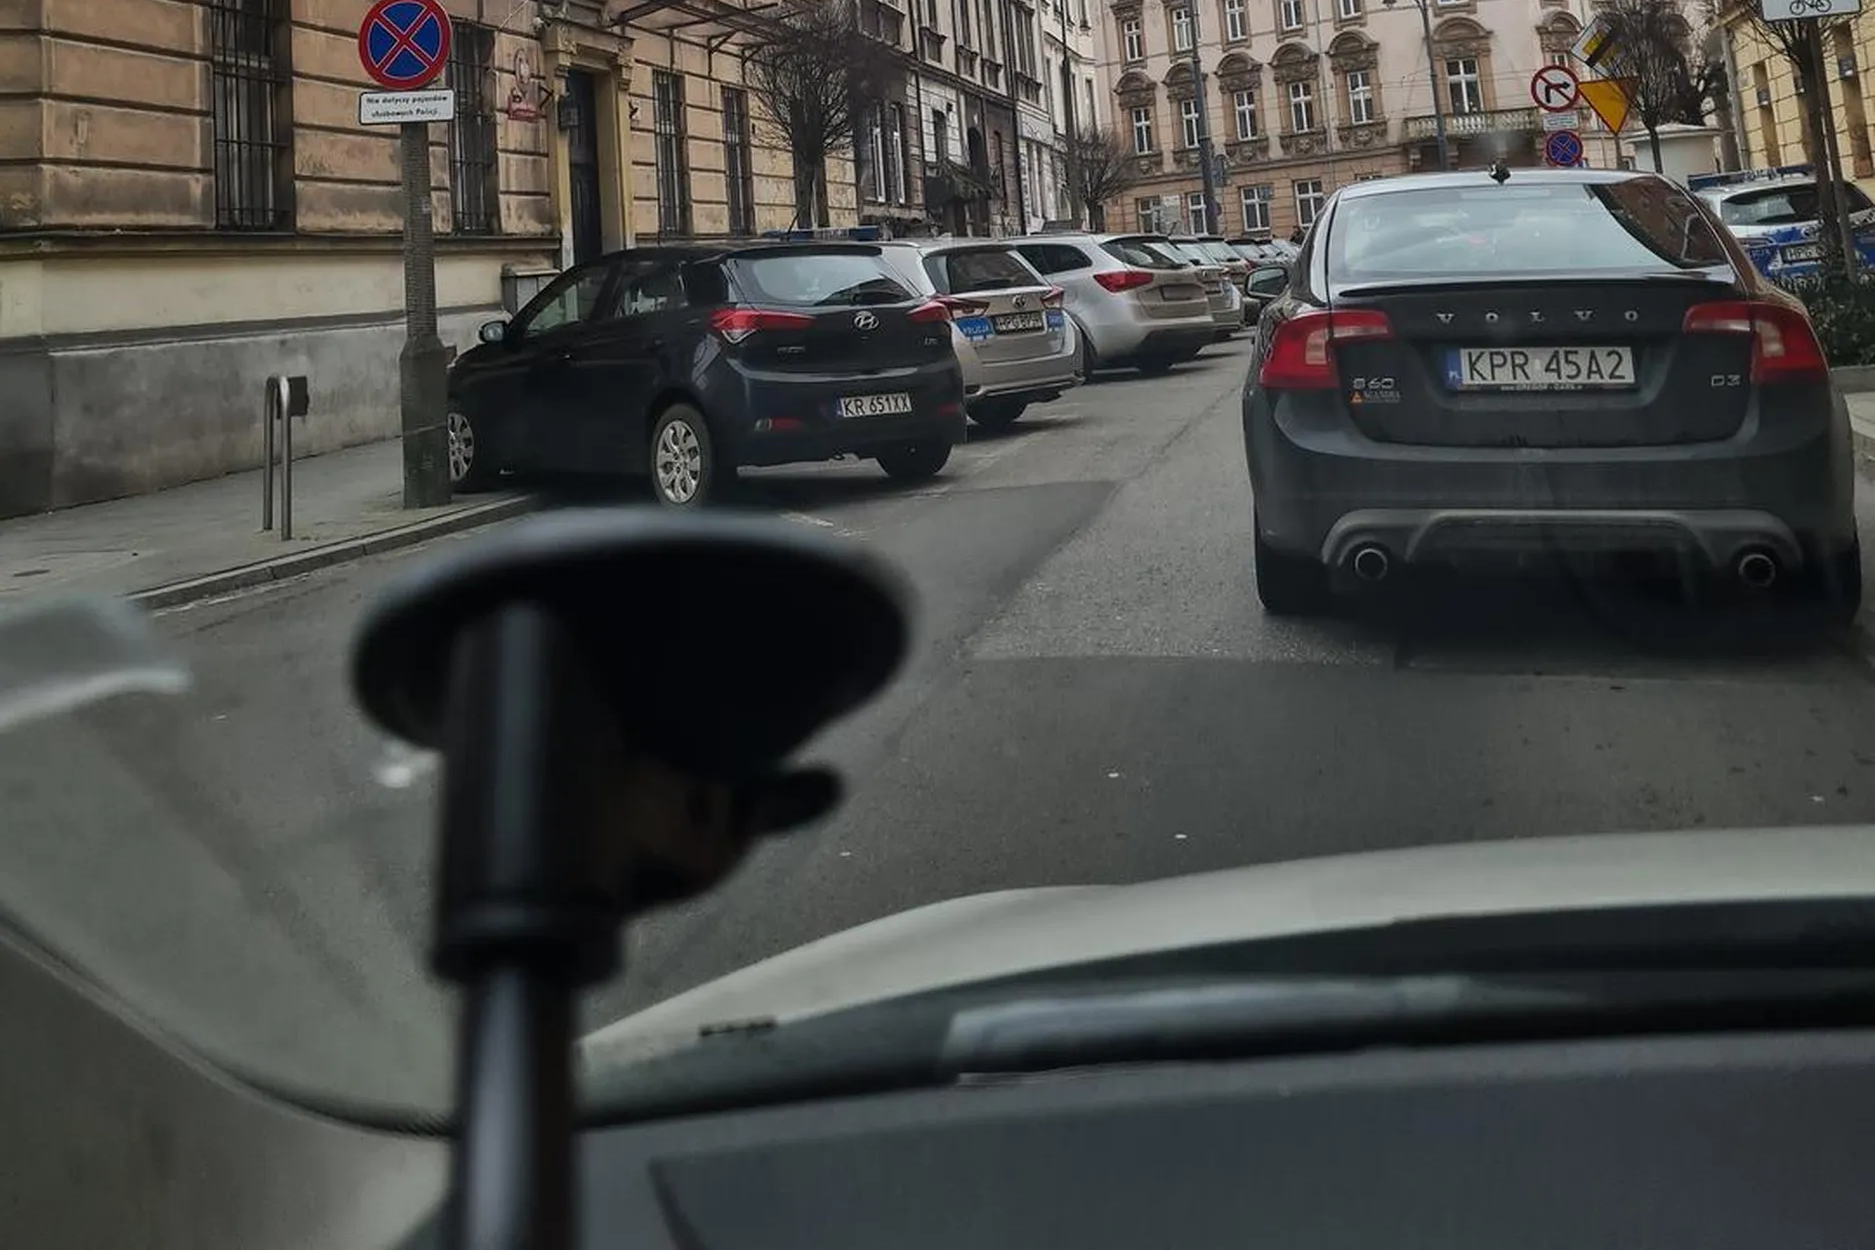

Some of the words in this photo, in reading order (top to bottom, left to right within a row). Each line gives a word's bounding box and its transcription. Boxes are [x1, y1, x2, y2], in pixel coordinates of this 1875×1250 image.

[1436, 310, 1639, 324] VOLVO
[1467, 351, 1531, 381] KPR
[1544, 350, 1626, 381] 45A2
[1711, 374, 1741, 387] D3
[843, 398, 866, 416] KR
[868, 393, 910, 414] 651XX
